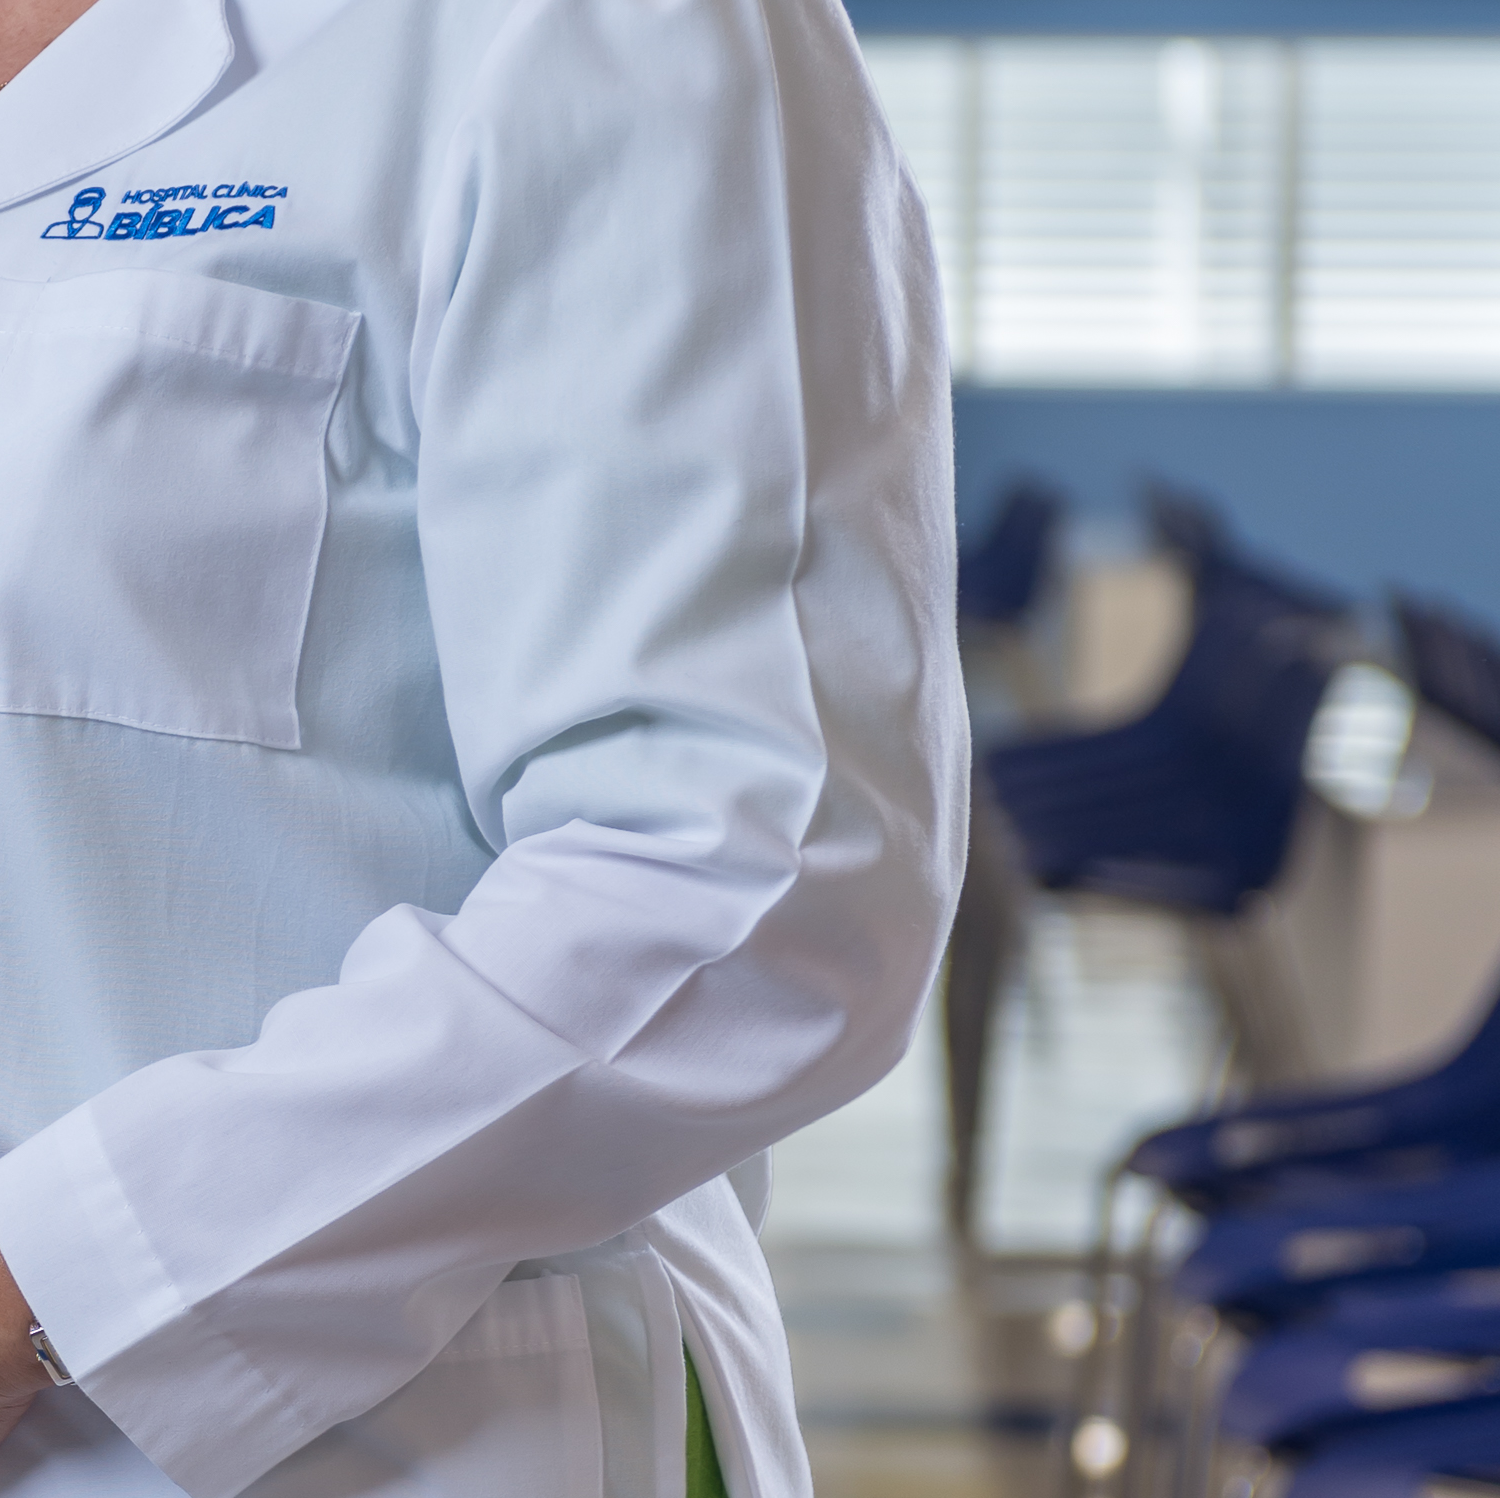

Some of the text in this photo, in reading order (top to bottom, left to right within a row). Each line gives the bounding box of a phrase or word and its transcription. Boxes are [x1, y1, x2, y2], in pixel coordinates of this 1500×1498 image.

[121, 181, 288, 204] HOSPITAL CLÍNICA
[103, 204, 276, 240] BÍBLICA
